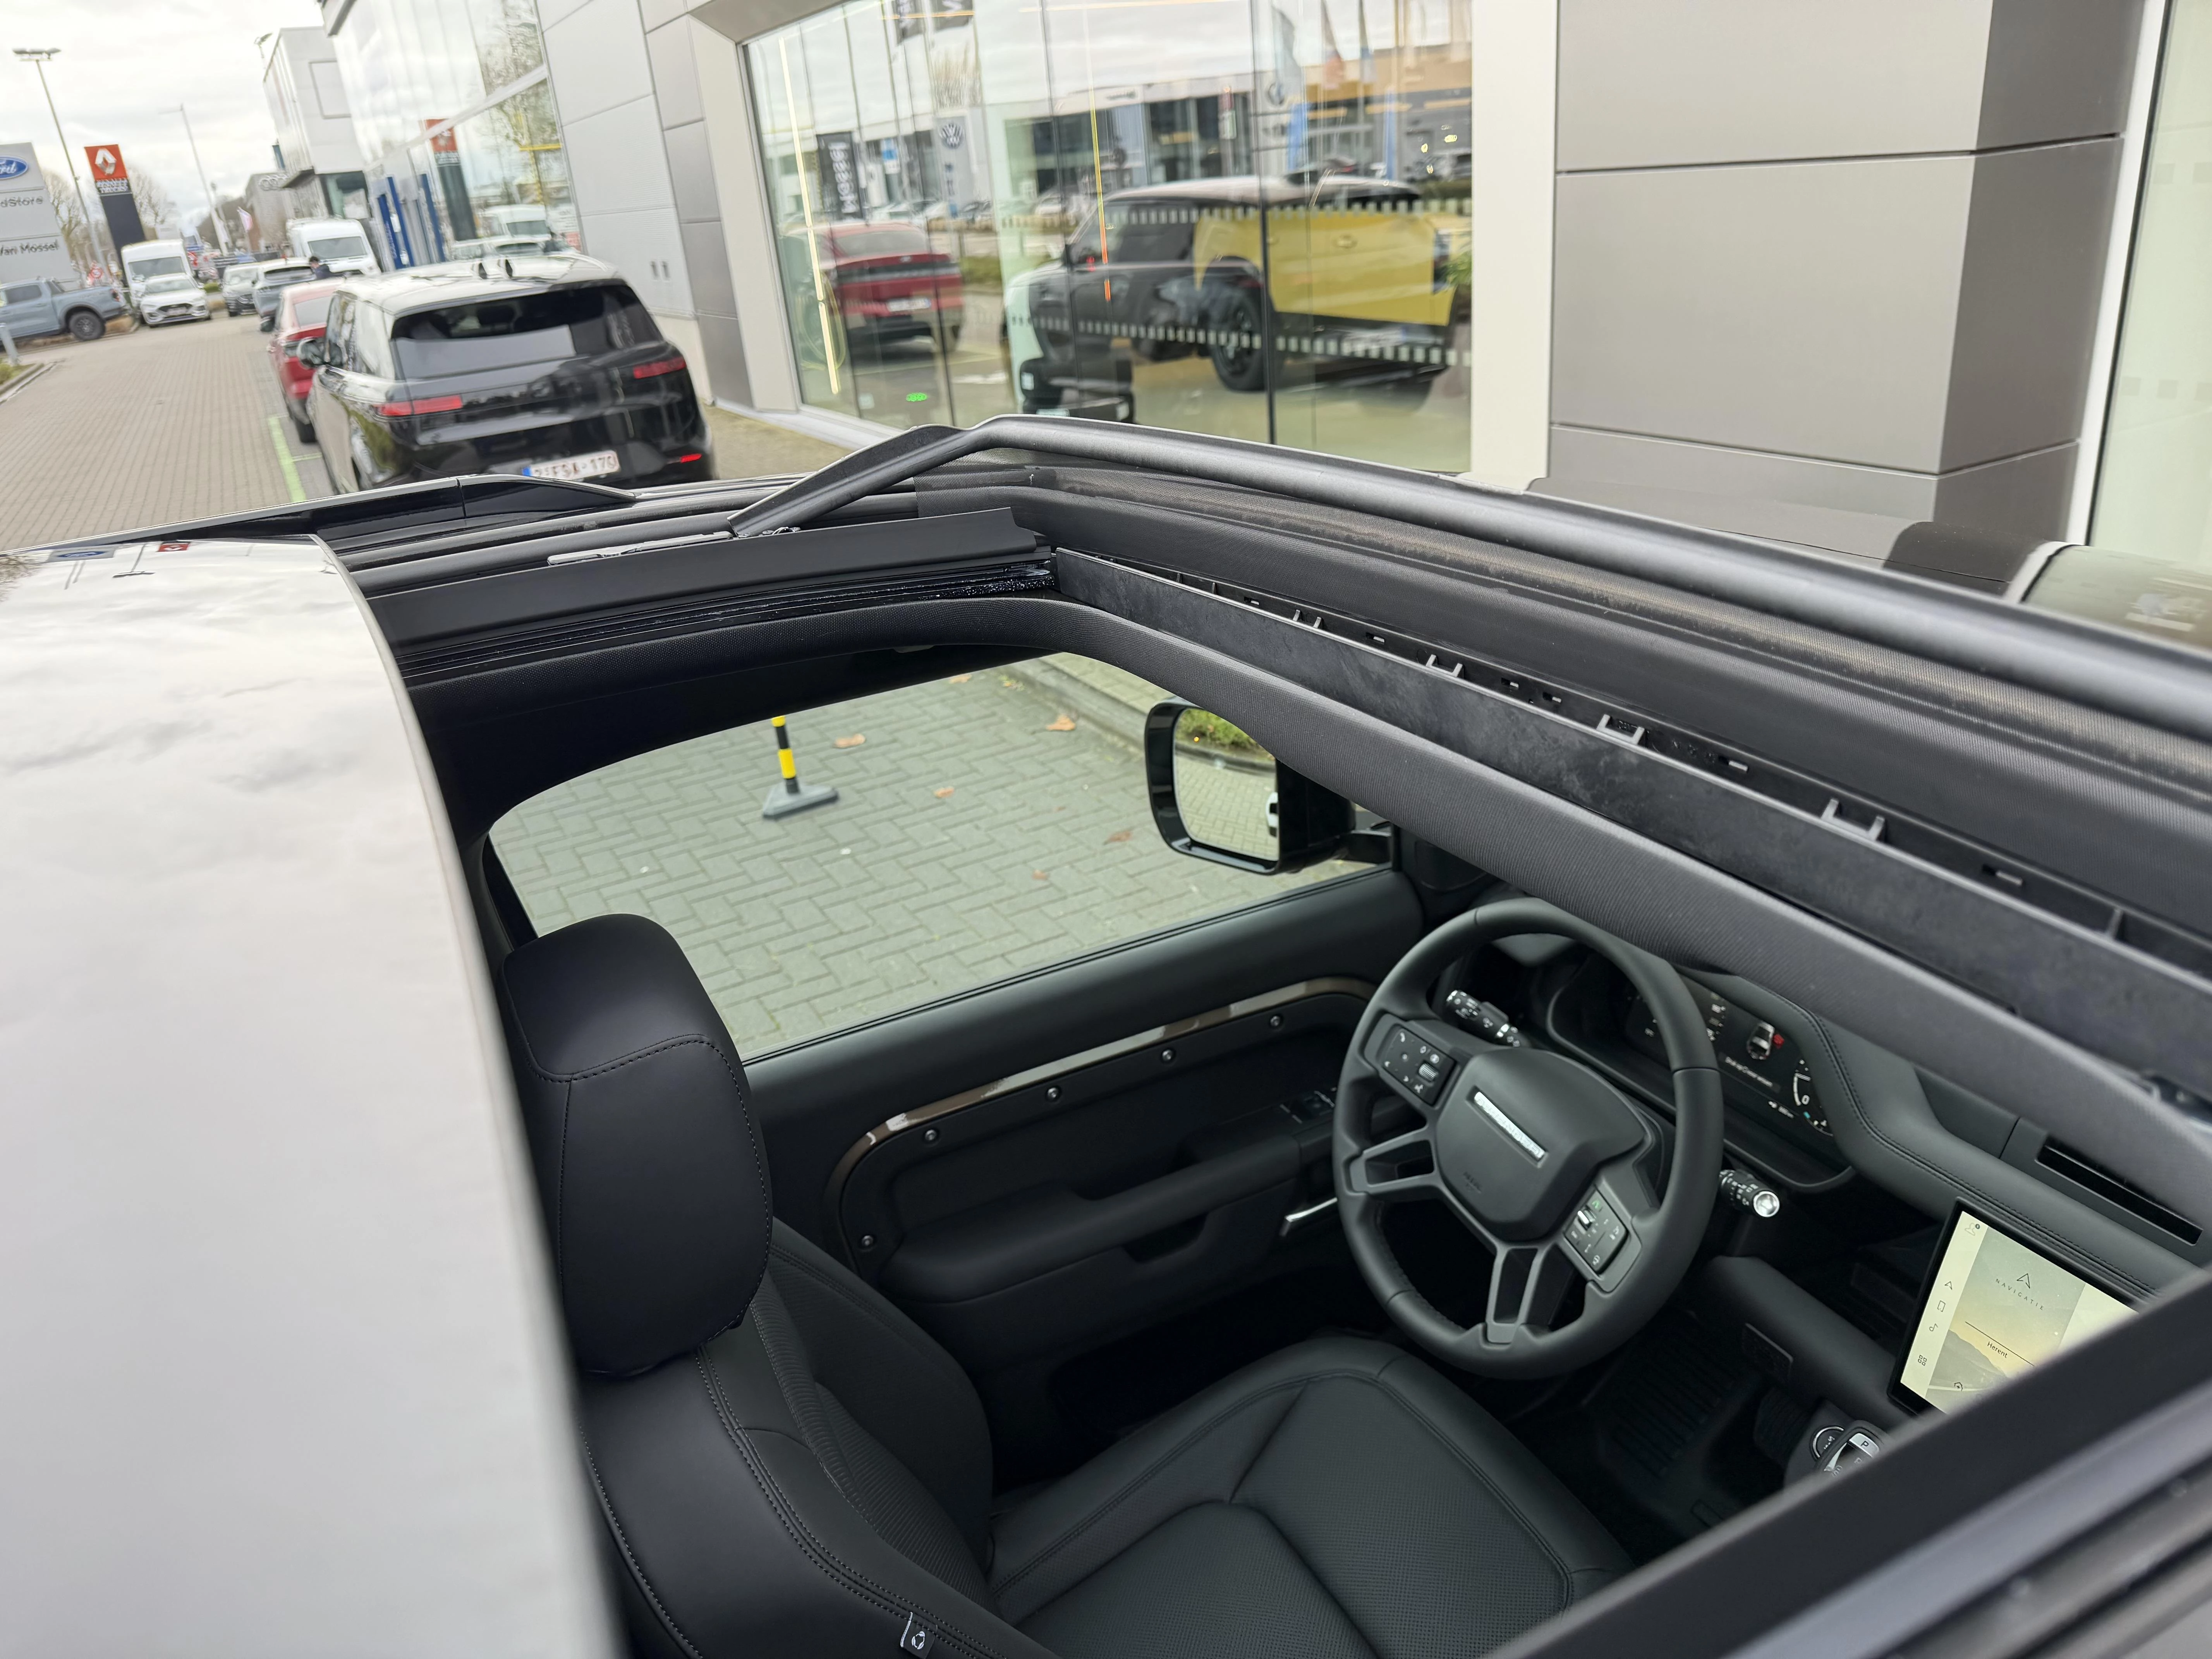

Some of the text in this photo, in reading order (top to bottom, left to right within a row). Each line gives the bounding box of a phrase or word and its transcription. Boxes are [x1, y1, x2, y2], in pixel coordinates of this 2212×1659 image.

[20, 239, 59, 254] Mossel
[1996, 1279, 2044, 1310] NAVIGATIE
[1987, 1341, 2008, 1358] Herent
